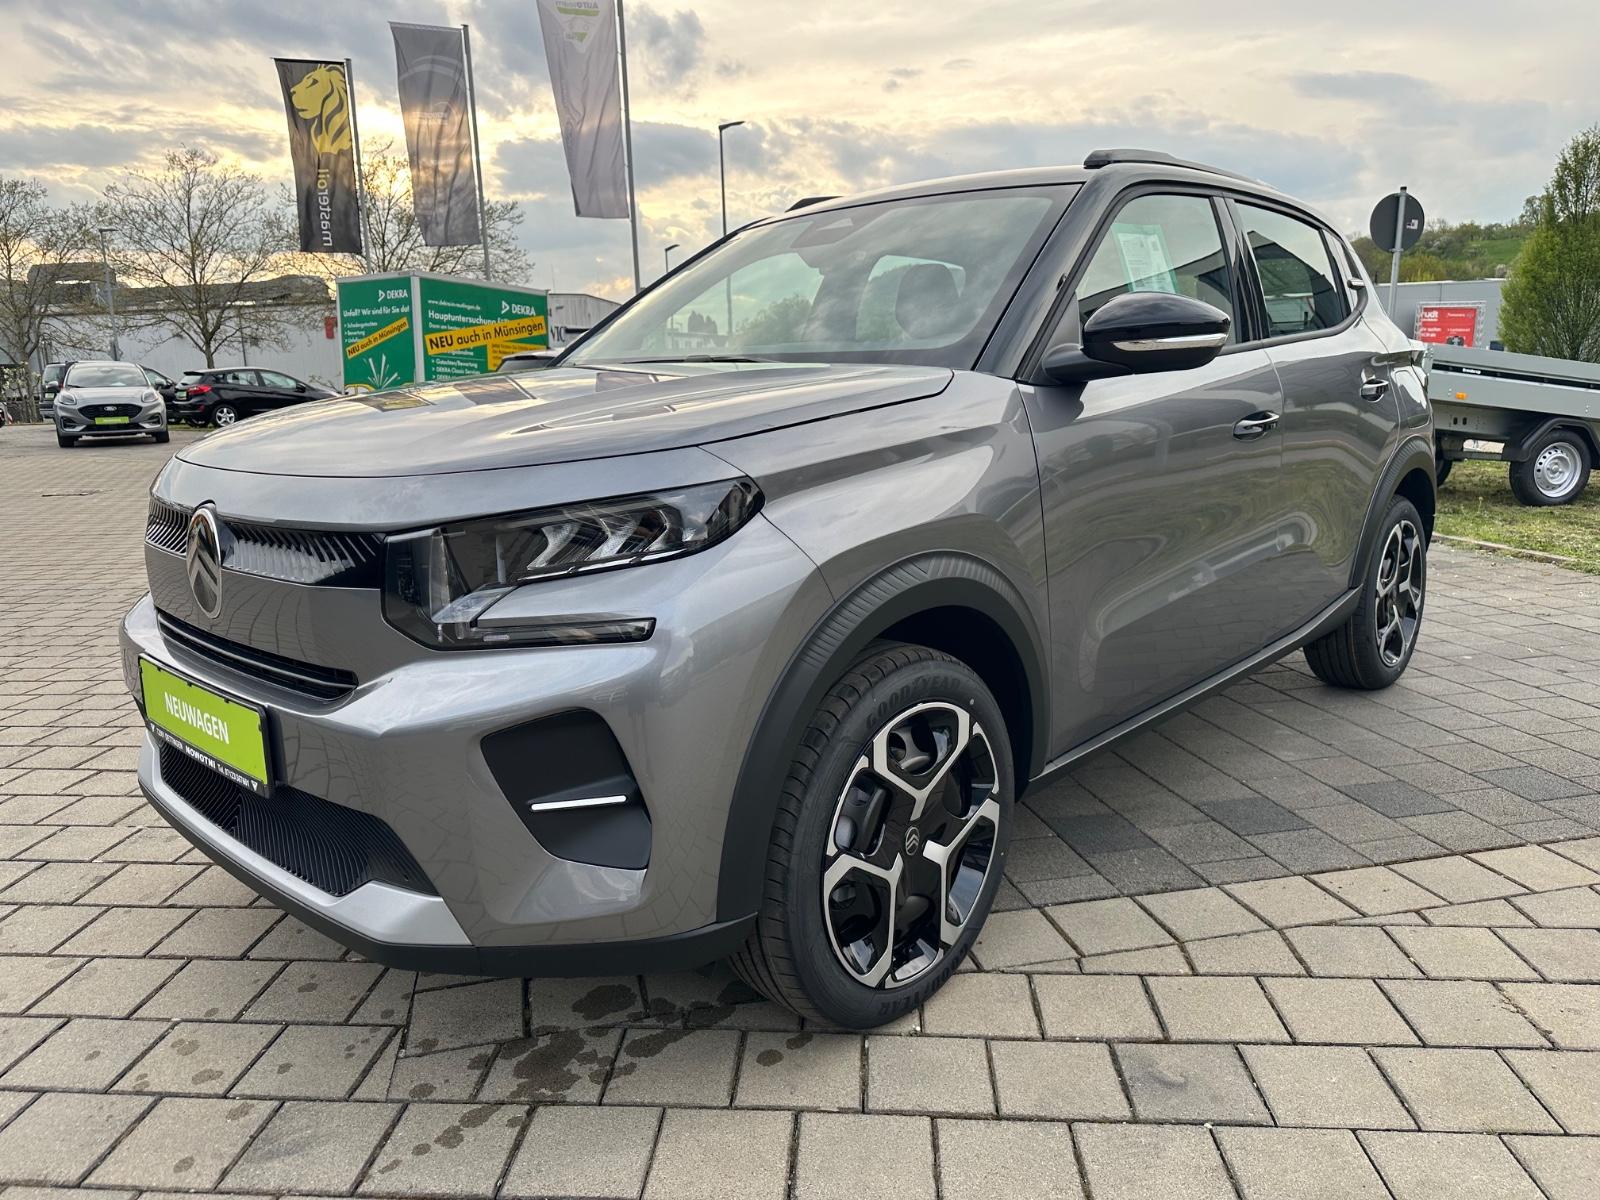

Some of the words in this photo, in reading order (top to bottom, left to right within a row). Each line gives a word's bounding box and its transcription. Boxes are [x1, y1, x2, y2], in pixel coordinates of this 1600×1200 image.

[386, 289, 408, 299] DEKRA
[343, 308, 360, 317] Unfall?
[361, 308, 371, 316] Wir
[372, 306, 382, 315] sind
[511, 304, 536, 316] DEKRA
[348, 344, 360, 356] NEU
[361, 337, 373, 349] auch
[373, 335, 379, 343] in
[378, 321, 407, 341] Münsingen
[429, 335, 454, 350] NEU
[456, 329, 481, 345] auch
[482, 329, 492, 340] in
[494, 321, 543, 338] Münsingen
[164, 691, 230, 745] NEUWAGEN
